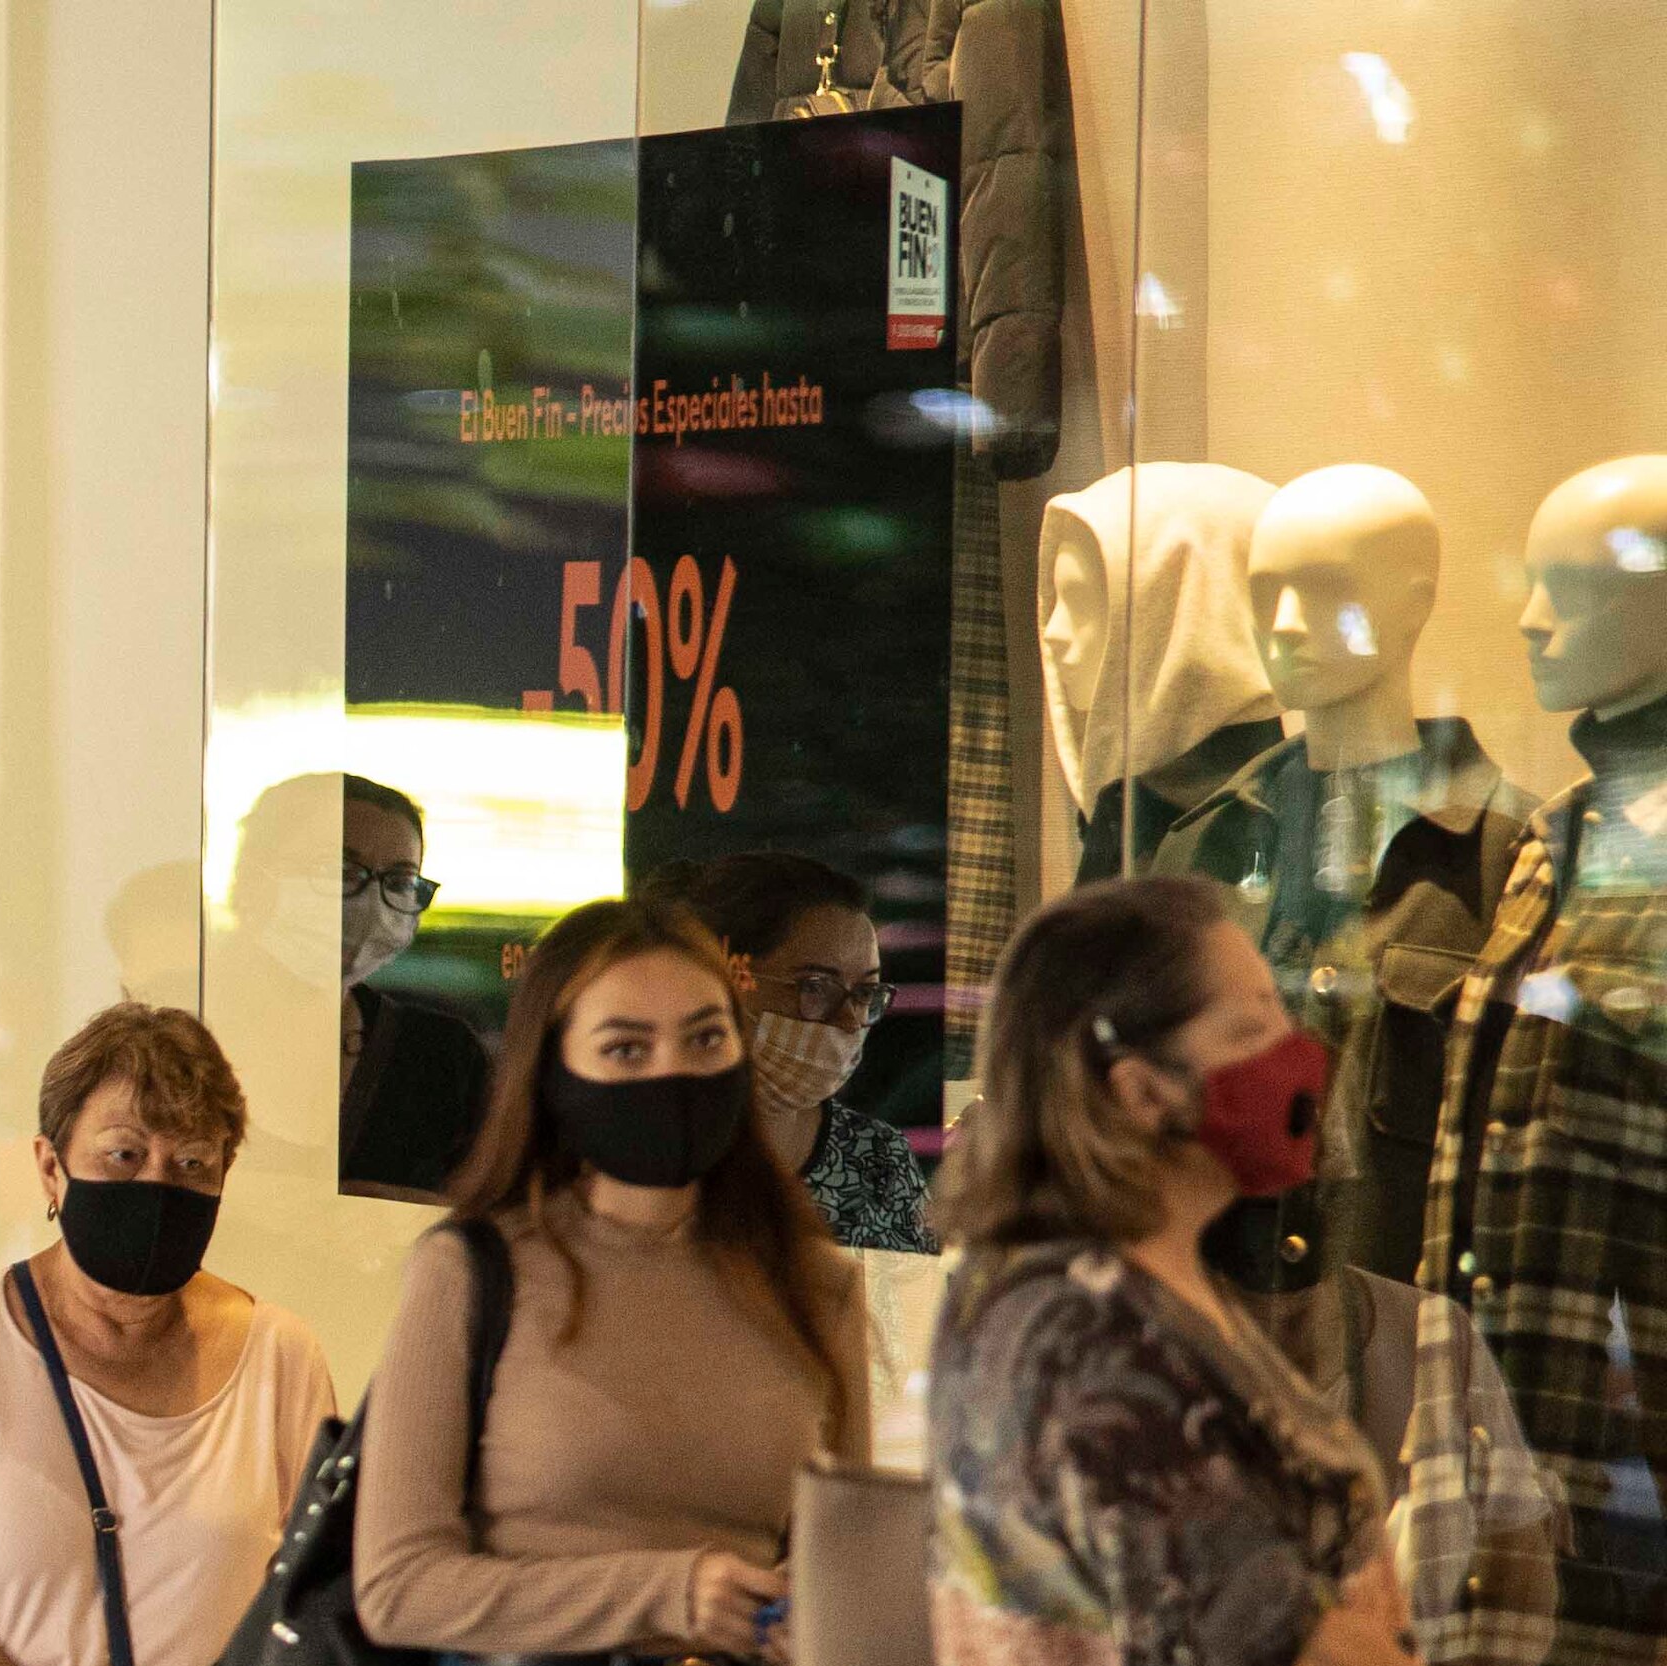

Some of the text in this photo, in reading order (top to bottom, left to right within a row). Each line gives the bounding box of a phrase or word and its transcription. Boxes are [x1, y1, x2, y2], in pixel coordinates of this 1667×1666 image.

[899, 191, 938, 238] BUEN
[897, 231, 928, 279] FIN
[460, 389, 479, 443] El
[482, 389, 527, 441] Buen
[533, 386, 563, 438] Fin
[653, 374, 759, 448] Especiales
[763, 370, 823, 427] hasta
